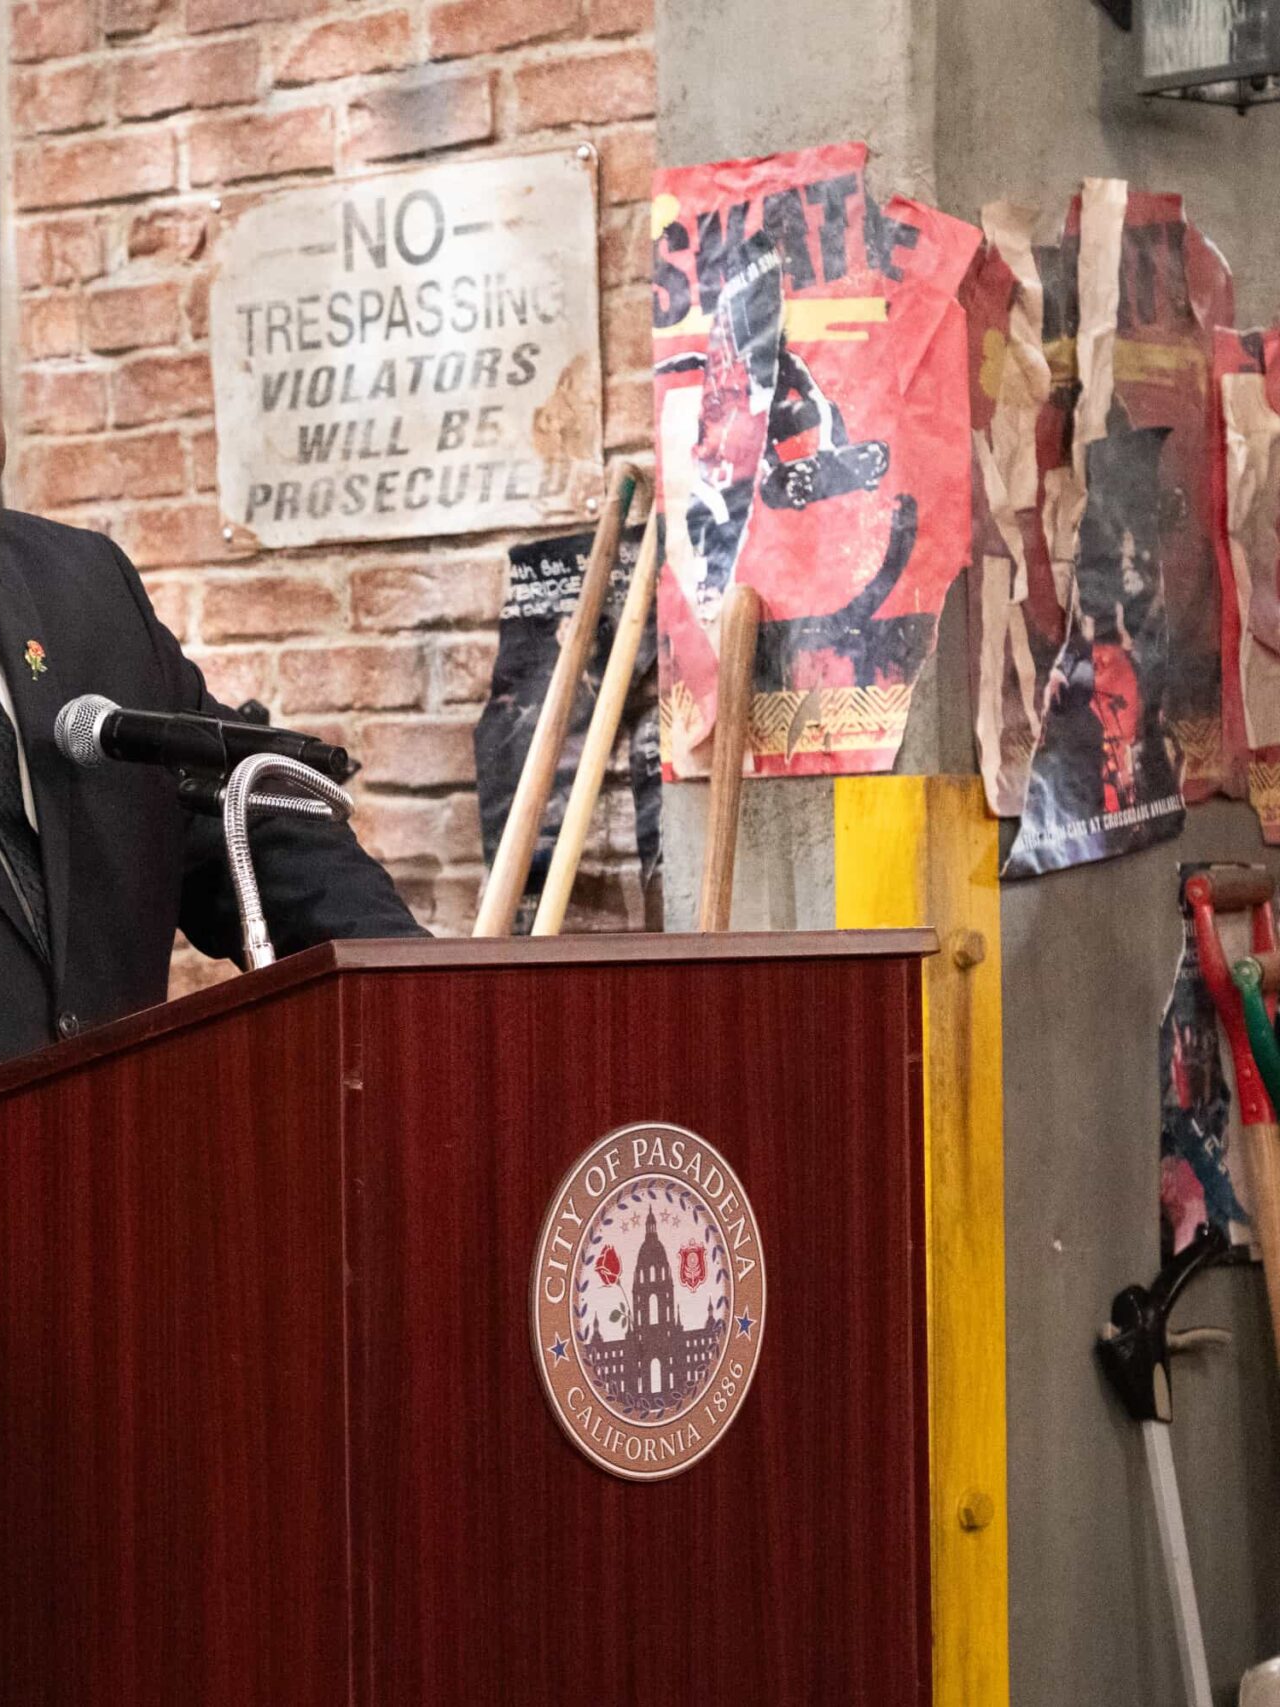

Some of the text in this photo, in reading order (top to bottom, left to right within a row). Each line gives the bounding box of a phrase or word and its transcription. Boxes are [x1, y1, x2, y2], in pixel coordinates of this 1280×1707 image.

[342, 189, 446, 272] NO
[237, 274, 567, 357] TRESPASSING
[261, 342, 540, 412] VIOLATORS
[297, 404, 505, 464] WILL BE
[244, 459, 568, 523] PROSECUTED
[545, 1136, 757, 1305] CITY OF PASADENA
[567, 1358, 744, 1462] CALIFORNIA 1886
